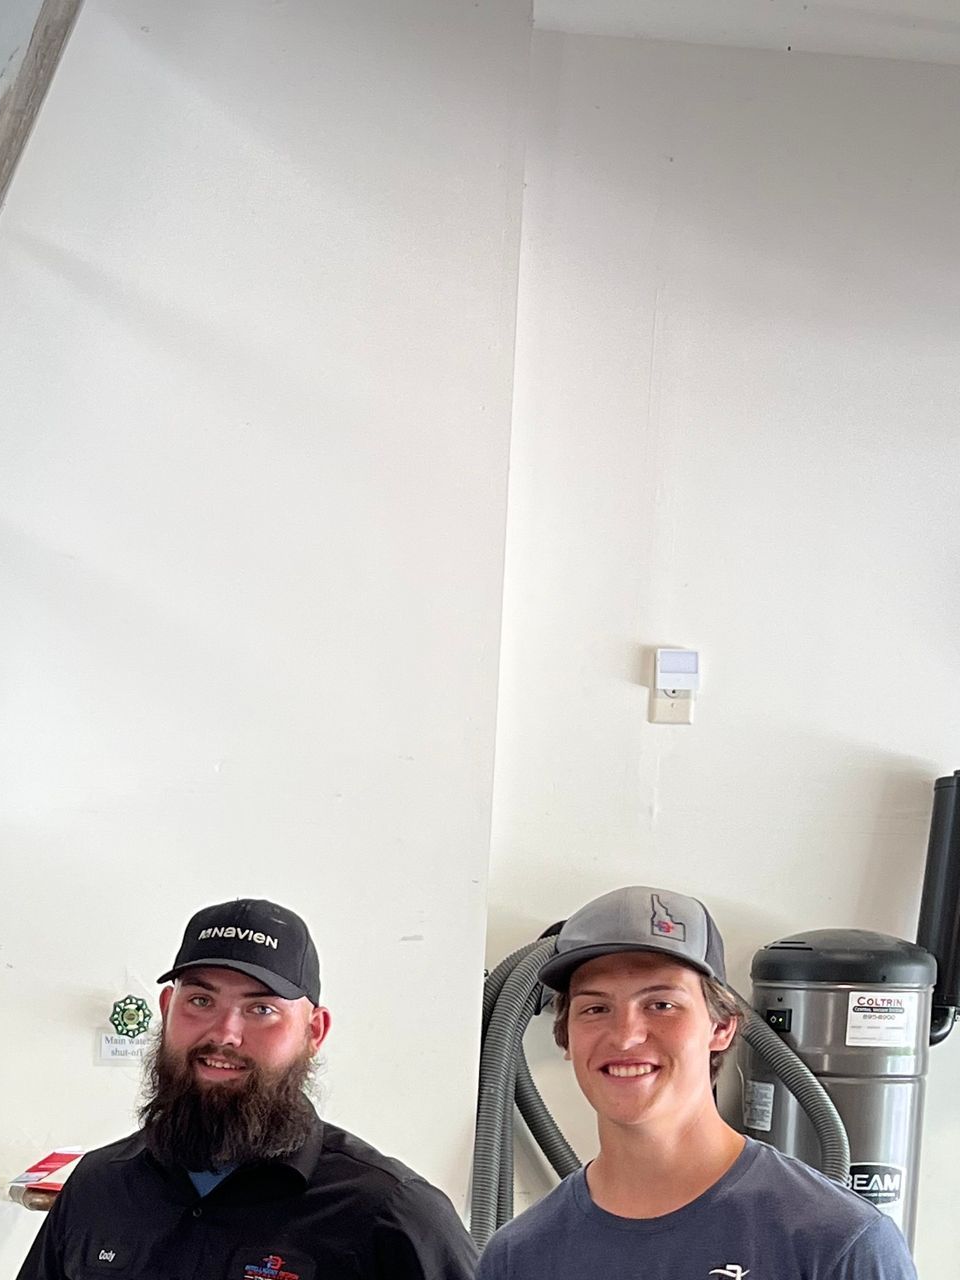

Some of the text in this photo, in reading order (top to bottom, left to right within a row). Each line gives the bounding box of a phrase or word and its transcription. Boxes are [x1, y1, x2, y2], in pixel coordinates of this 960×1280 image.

[857, 996, 903, 1006] COLTRIN
[104, 1036, 126, 1044] Main
[99, 1249, 116, 1262] Cody
